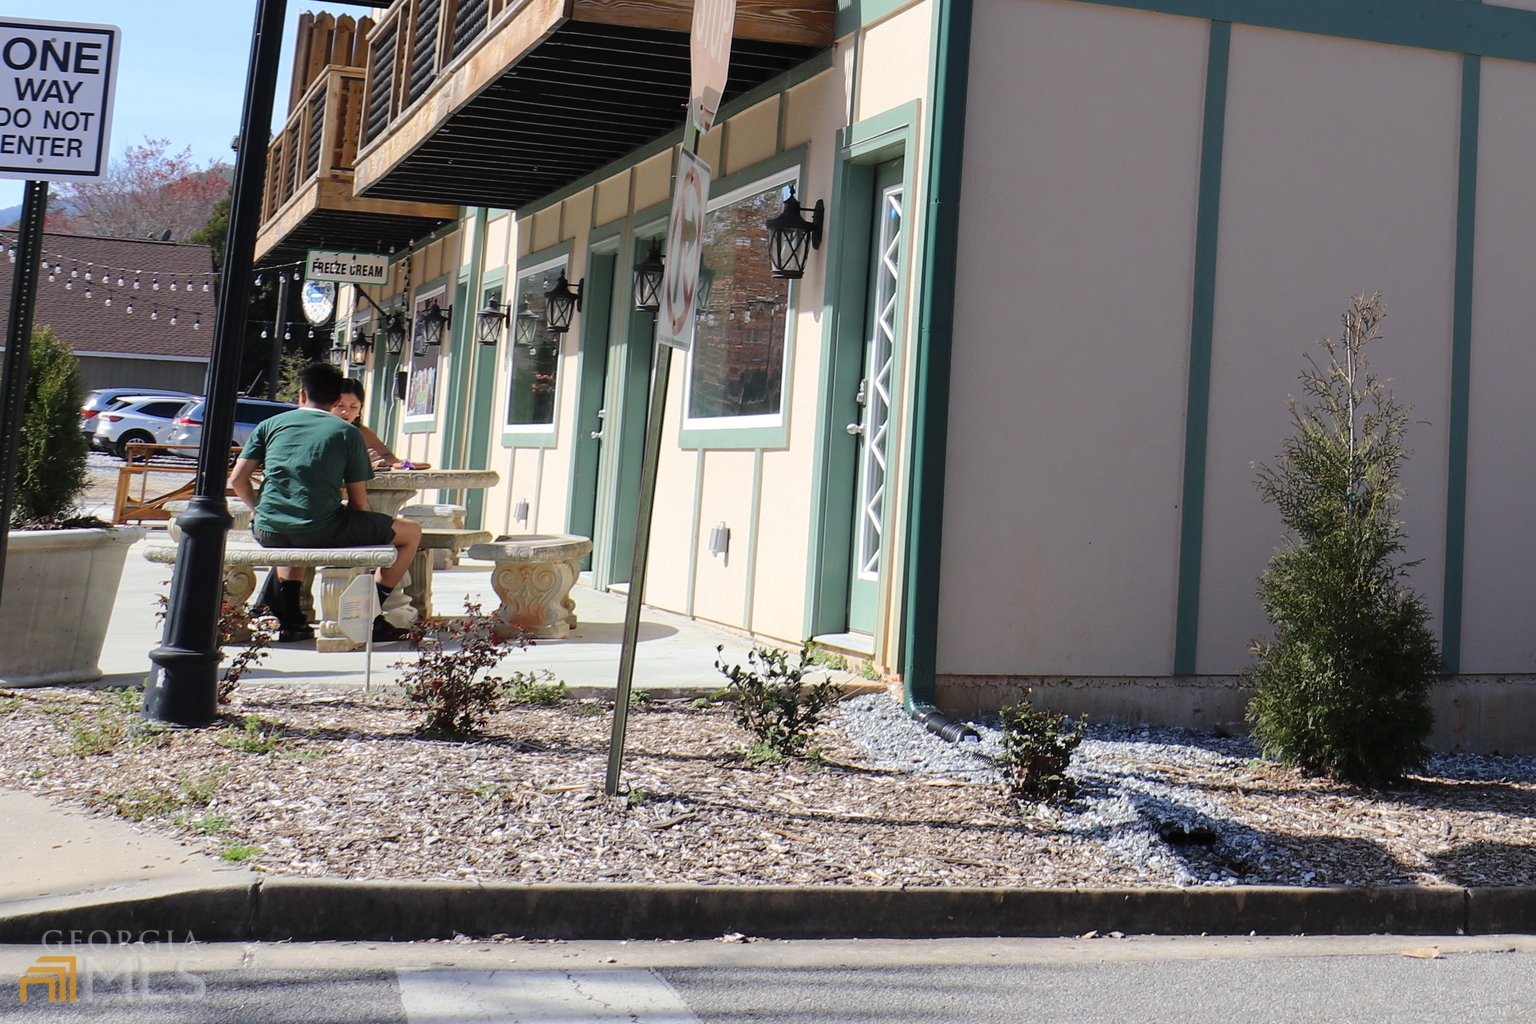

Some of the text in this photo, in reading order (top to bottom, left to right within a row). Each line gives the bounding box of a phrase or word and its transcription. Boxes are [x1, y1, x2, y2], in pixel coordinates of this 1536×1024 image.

[2, 37, 102, 75] ONE
[14, 77, 84, 104] WAY
[43, 109, 95, 131] NOT
[0, 134, 83, 158] ENTER
[312, 262, 383, 277] FREEZE CREAM
